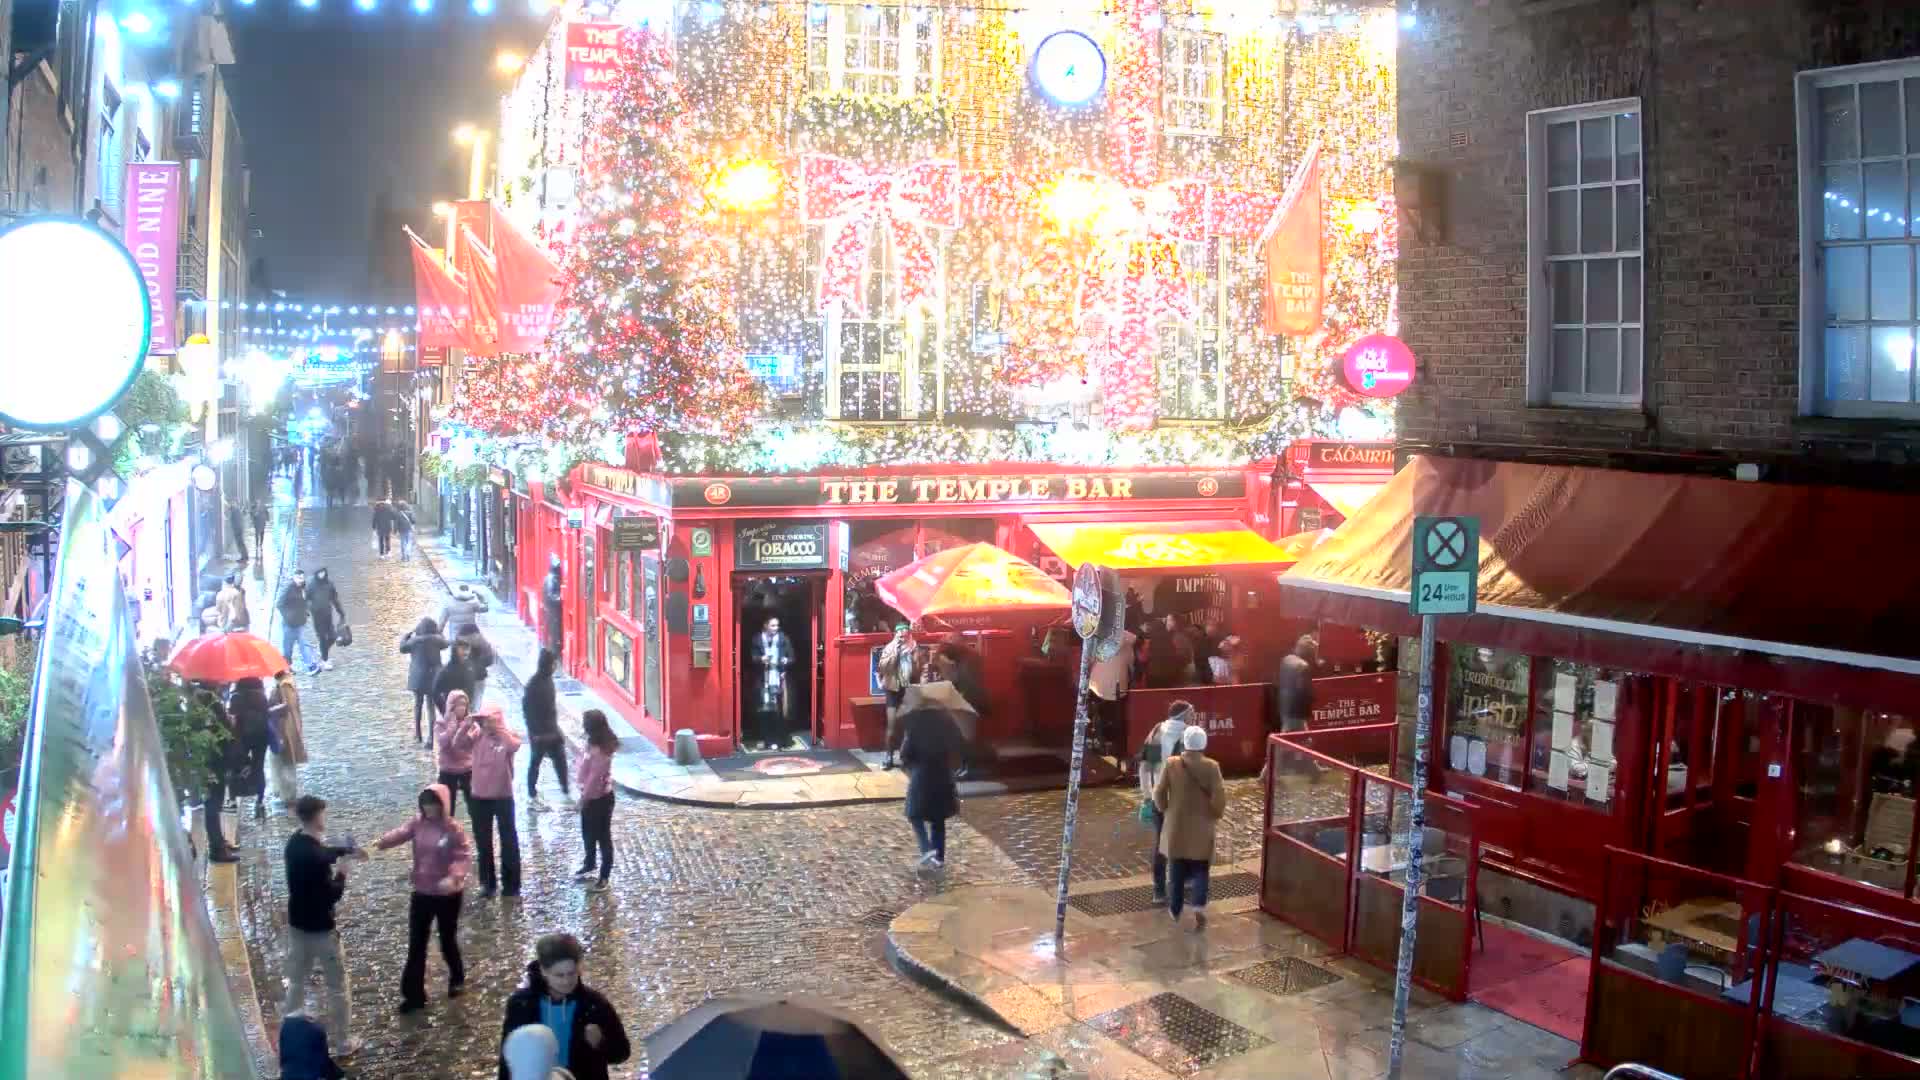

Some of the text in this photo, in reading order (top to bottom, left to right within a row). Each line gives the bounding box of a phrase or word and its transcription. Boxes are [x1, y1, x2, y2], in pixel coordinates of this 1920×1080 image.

[584, 28, 617, 45] THE
[137, 171, 169, 232] NINE
[1290, 271, 1313, 283] THE
[519, 303, 545, 314] THE
[1286, 299, 1313, 313] BAR
[823, 477, 1133, 504] THE TEMPLE BAR
[748, 538, 816, 562] TOBACCO
[847, 565, 890, 587] TEMPLE
[1422, 583, 1443, 602] 24
[1337, 699, 1356, 708] THE
[1312, 704, 1381, 721] TEMPLE BAR
[1208, 718, 1235, 729] BAR
